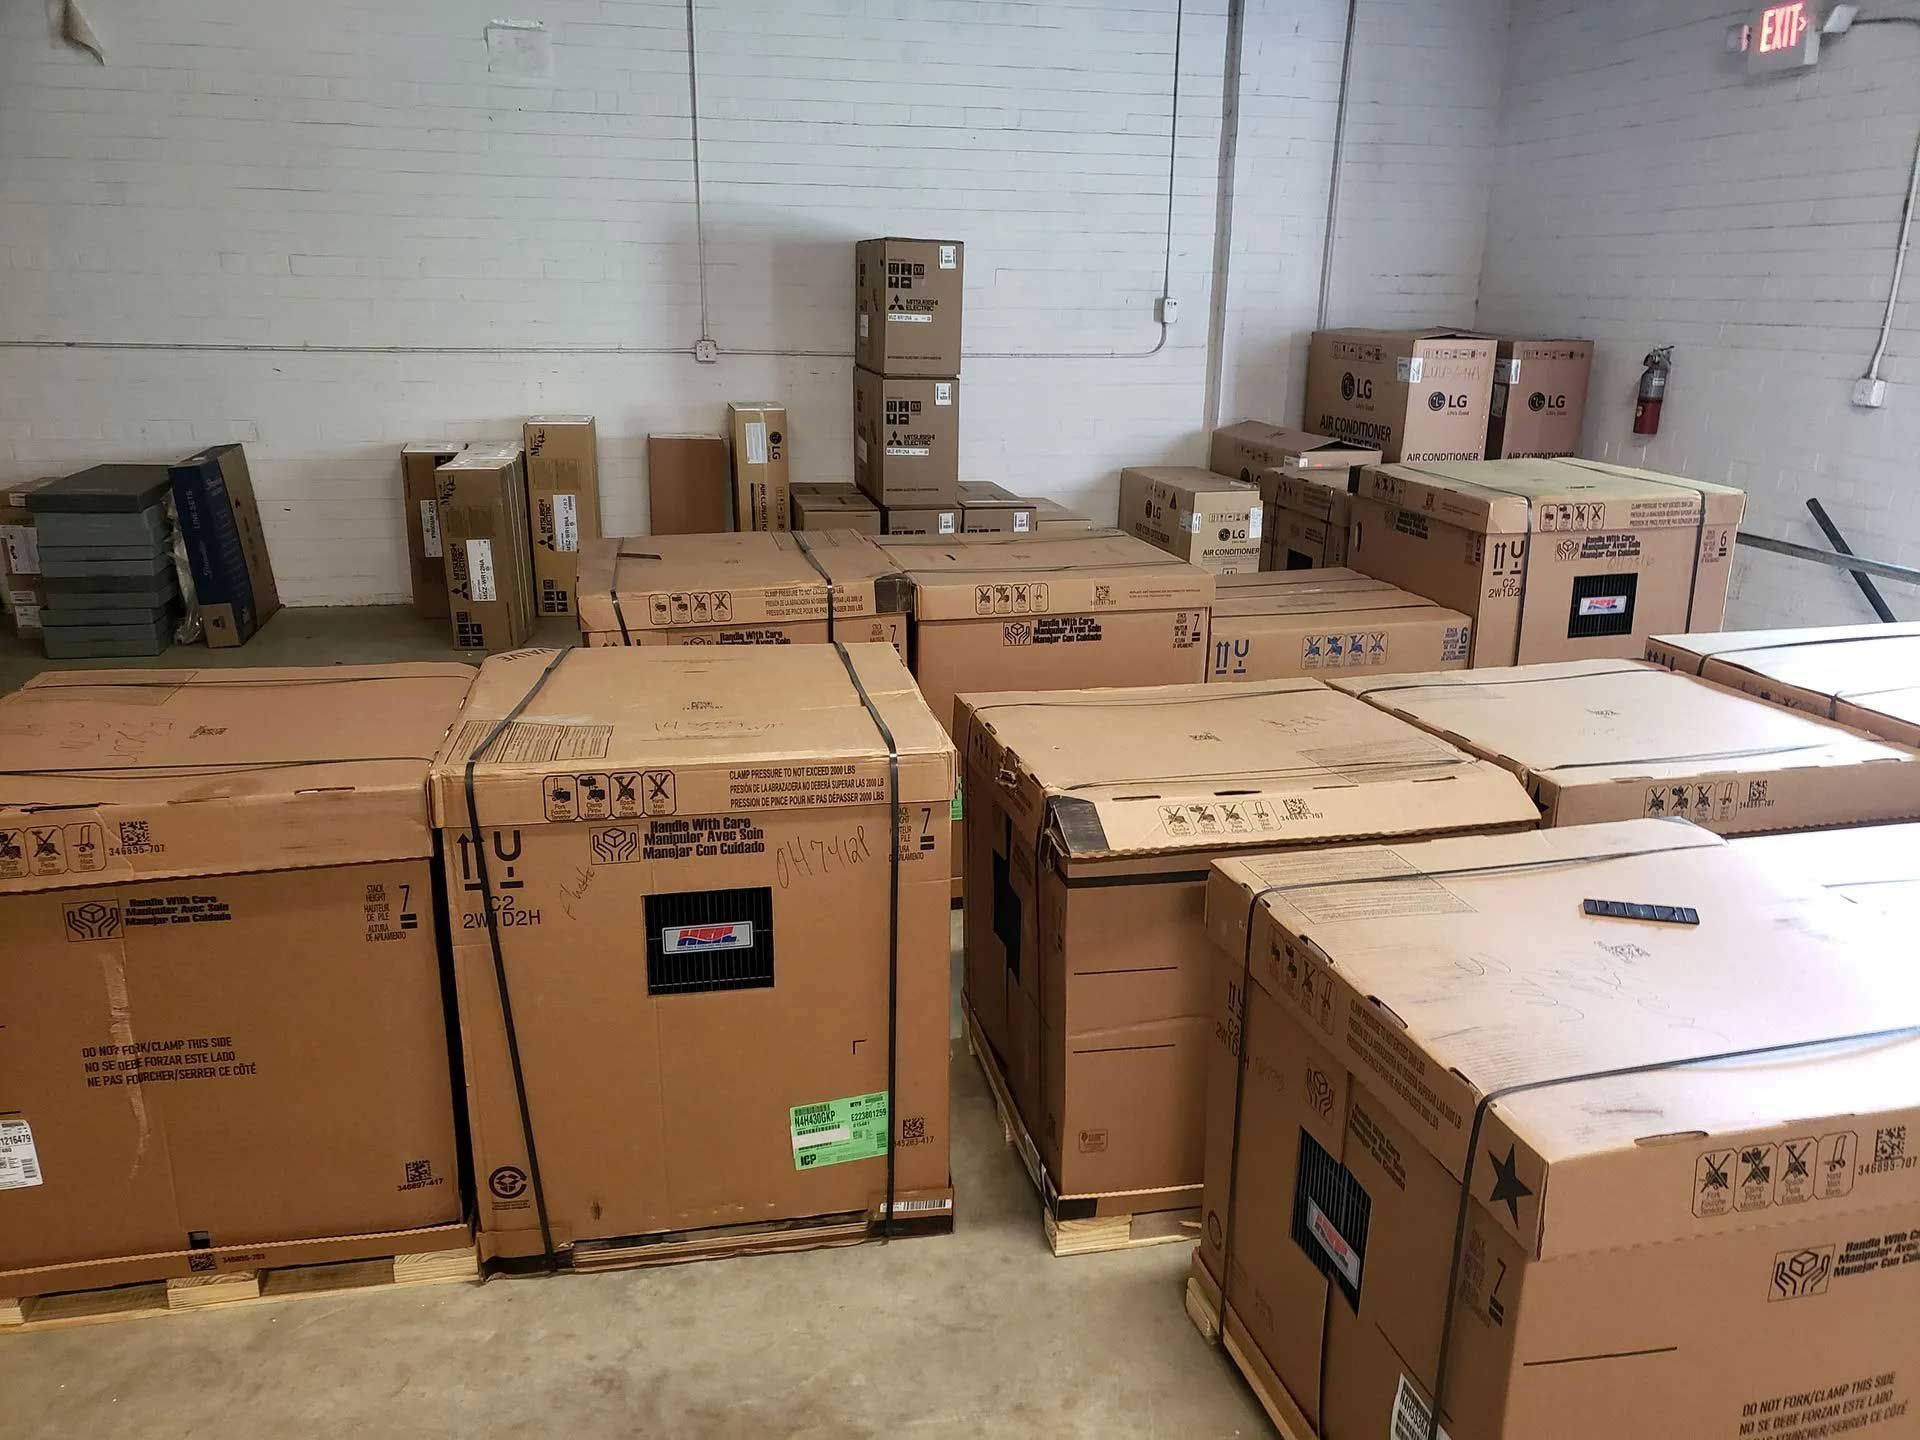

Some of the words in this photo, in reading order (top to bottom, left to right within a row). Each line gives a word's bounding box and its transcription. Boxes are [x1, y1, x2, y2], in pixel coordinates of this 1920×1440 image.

[1760, 3, 1803, 52] EXIT
[1356, 377, 1372, 399] LG
[1448, 394, 1467, 408] LG
[1547, 395, 1566, 409] LG
[1320, 415, 1334, 430] AIR
[1335, 417, 1391, 442] CONDITIONER
[771, 446, 782, 460] LG
[1406, 453, 1421, 462] AIR
[1422, 452, 1479, 461] CONDITIONER
[538, 499, 547, 534] MITSUBISHI
[545, 504, 553, 533] ELECTRIC
[1152, 504, 1161, 519] LG
[1232, 529, 1246, 539] LG
[1586, 536, 1605, 544] Handle
[1621, 534, 1635, 542] Care
[1720, 530, 1728, 547] 6
[1214, 547, 1260, 556] CONDITIONER
[1606, 549, 1616, 557] Con
[450, 543, 460, 581] MITSUBISHI
[456, 548, 467, 581] ELECTRIC
[1503, 578, 1515, 588] C2
[1488, 587, 1521, 598] 2W1D2
[1038, 619, 1060, 628] Handle
[1061, 618, 1078, 626] With
[1078, 617, 1095, 625] Care
[1069, 625, 1087, 633] Avec
[1194, 613, 1200, 631] 7
[720, 632, 745, 641] Handle
[745, 631, 764, 640] With
[765, 630, 783, 638] Care
[890, 624, 897, 643] 7
[1033, 635, 1061, 644] Manejar
[1062, 634, 1075, 642] Con
[1460, 627, 1469, 644] 6
[729, 769, 751, 780] CLAMP
[751, 768, 783, 779] PRESSURE
[784, 767, 792, 777] TO
[793, 767, 805, 777] NOT
[806, 766, 830, 777] EXCEED
[830, 765, 844, 776] 2000
[844, 765, 856, 775] LBS
[753, 783, 760, 793] DE
[761, 783, 768, 793] LA
[768, 781, 802, 792] ABRAZADERA
[802, 781, 810, 791] NO
[832, 779, 856, 789] SUPERAR
[855, 778, 866, 788] LAS
[730, 797, 760, 808] PRESSION
[761, 796, 770, 807] DE
[770, 796, 789, 806] PINCE
[789, 795, 806, 805] POUR
[806, 794, 815, 804] NE
[816, 794, 827, 804] PAS
[859, 791, 873, 802] 2000
[873, 791, 885, 801] LBS
[650, 819, 689, 833] Handle
[692, 818, 720, 831] With
[723, 817, 751, 830] Care
[921, 807, 932, 834] 7
[644, 831, 704, 847] Manipuler
[707, 830, 736, 842] Avec
[739, 827, 764, 840] Soin
[108, 844, 165, 857] 346895-707
[643, 846, 693, 860] Manejar
[696, 843, 717, 856] Con
[720, 841, 765, 855] Cuidado
[129, 898, 164, 907] Handle
[166, 896, 191, 905] With
[191, 895, 217, 904] Care
[365, 893, 386, 902] HEIGHT
[366, 884, 384, 894] STACK
[398, 884, 410, 913] 7
[489, 895, 515, 912] C2
[125, 906, 178, 916] Manipuler
[181, 905, 206, 914] Avec
[207, 903, 229, 912] Soin
[363, 903, 391, 914] HAUTEUR
[125, 916, 169, 926] Manejar
[171, 915, 191, 924] Con
[192, 912, 232, 922] Cuidado
[366, 912, 375, 922] DE
[377, 912, 390, 921] PILE
[367, 923, 390, 933] ALTURA
[365, 933, 374, 942] DE
[374, 931, 407, 941] APILAMIENTO
[82, 1047, 97, 1058] DO
[99, 1045, 120, 1056] NOT
[122, 1039, 185, 1055] FORK/CLAMP
[187, 1038, 209, 1050] THIS
[211, 1036, 233, 1048] SIDE
[85, 1062, 99, 1073] NO
[102, 1061, 115, 1071] SE
[118, 1058, 144, 1071] DEBE
[145, 1054, 182, 1068] FORZAR
[185, 1052, 209, 1064] ESTE
[211, 1050, 236, 1062] LADO
[87, 1076, 102, 1088] NE
[104, 1075, 123, 1086] PAS
[126, 1066, 216, 1085] FOURCHER/SERRER
[218, 1066, 231, 1077] CE
[233, 1062, 257, 1076] CÔTÉ
[800, 1153, 817, 1166] ICP
[1858, 1156, 1918, 1176] 346895-707
[1845, 1238, 1881, 1252] Handle
[1884, 1232, 1907, 1245] With
[1838, 1247, 1892, 1265] Manipuler
[1894, 1240, 1919, 1254] Avec
[1833, 1261, 1879, 1277] Manejar
[1880, 1257, 1900, 1269] Con
[1742, 1402, 1758, 1417] DO
[1759, 1398, 1781, 1414] NOT
[1783, 1383, 1850, 1410] FORK/CLAMP
[1851, 1377, 1872, 1394] THIS
[1875, 1370, 1896, 1388] SIDE
[1739, 1422, 1755, 1436] NO
[1758, 1419, 1773, 1432] SE
[1773, 1411, 1800, 1430] DEBE
[1801, 1402, 1841, 1425] FORZAR
[1842, 1397, 1865, 1414] ESTE
[1868, 1389, 1893, 1408] LADO
[1870, 1412, 1881, 1426] CE
